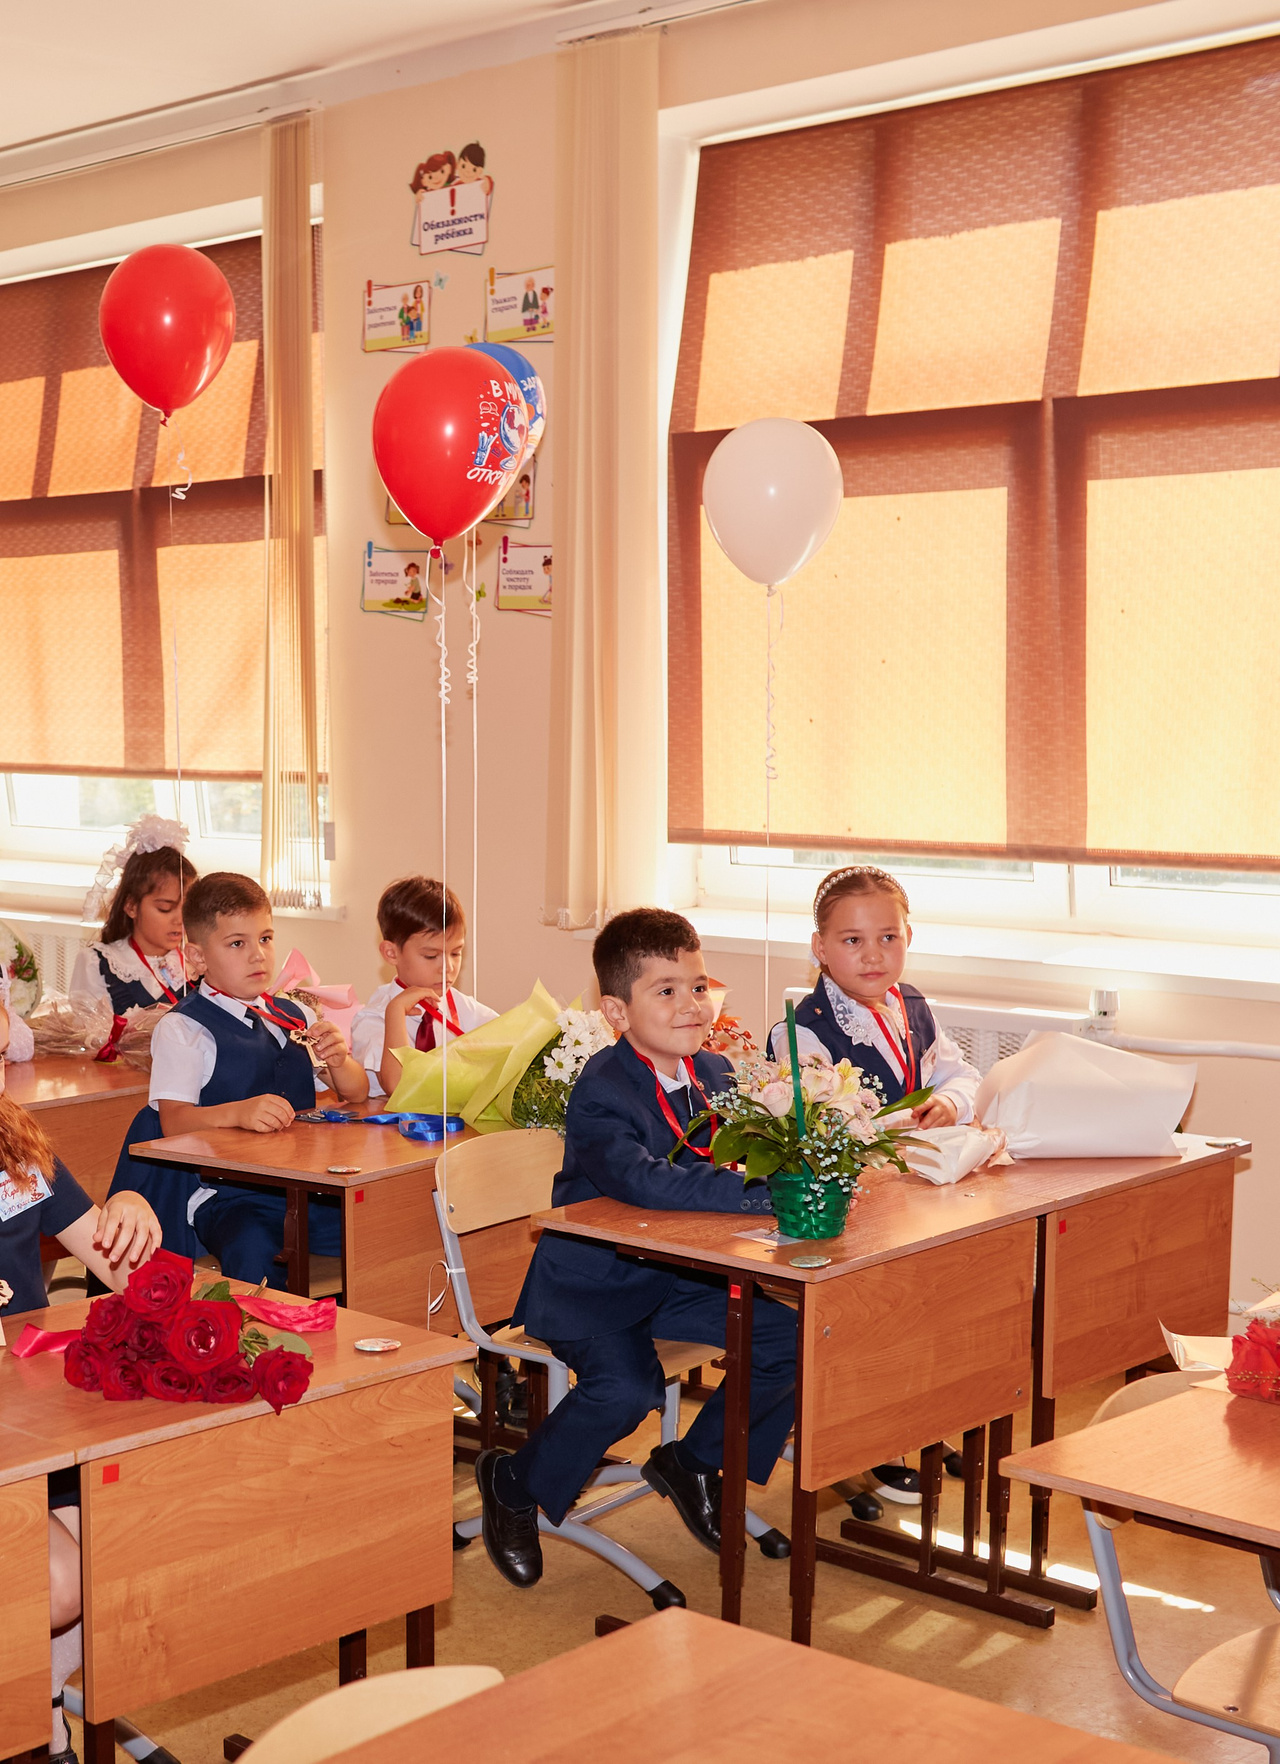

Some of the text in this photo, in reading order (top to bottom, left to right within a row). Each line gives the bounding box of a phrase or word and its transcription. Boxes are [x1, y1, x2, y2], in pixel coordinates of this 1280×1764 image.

[422, 213, 485, 232] Обязанности
[434, 227, 474, 245] ребёнка
[489, 379, 504, 398] В
